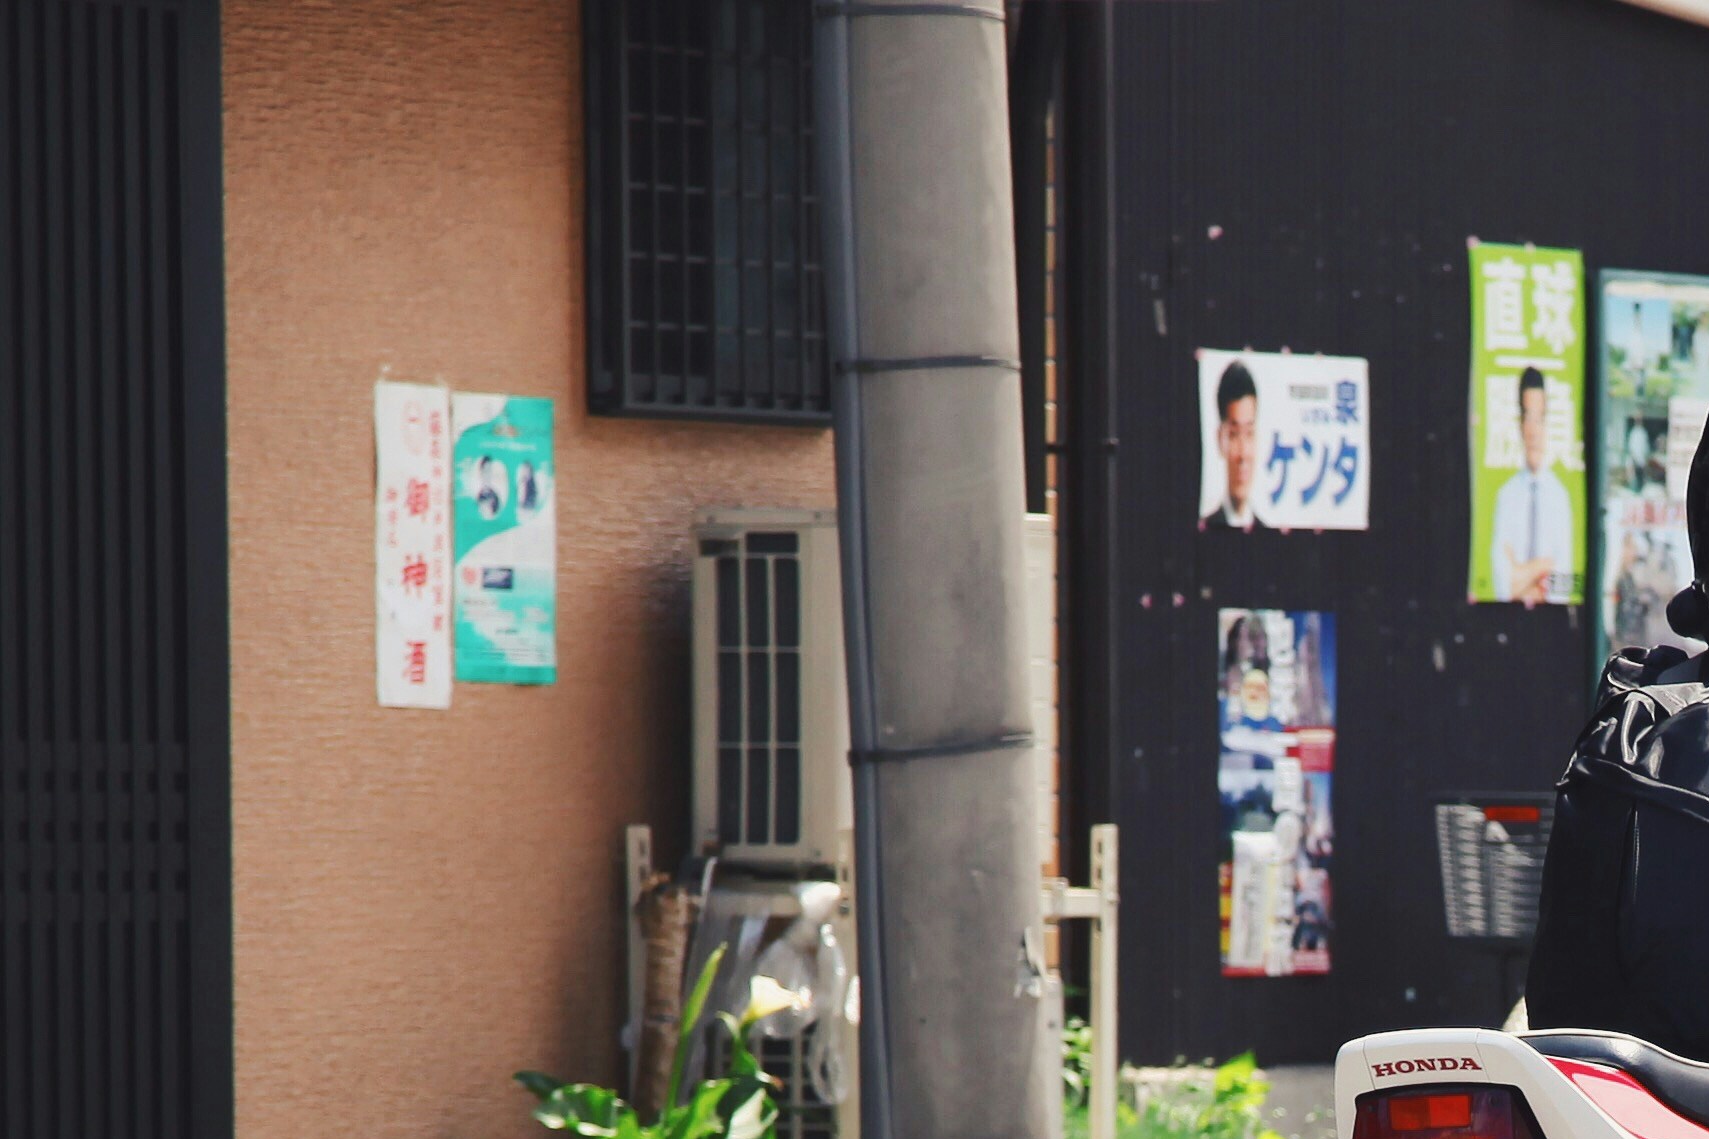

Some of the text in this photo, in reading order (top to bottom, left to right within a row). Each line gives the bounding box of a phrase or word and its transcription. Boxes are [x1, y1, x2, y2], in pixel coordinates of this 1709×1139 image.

[1481, 257, 1577, 355] 直球
[1266, 430, 1359, 507] ケンタ
[1371, 1056, 1482, 1078] HONDA
